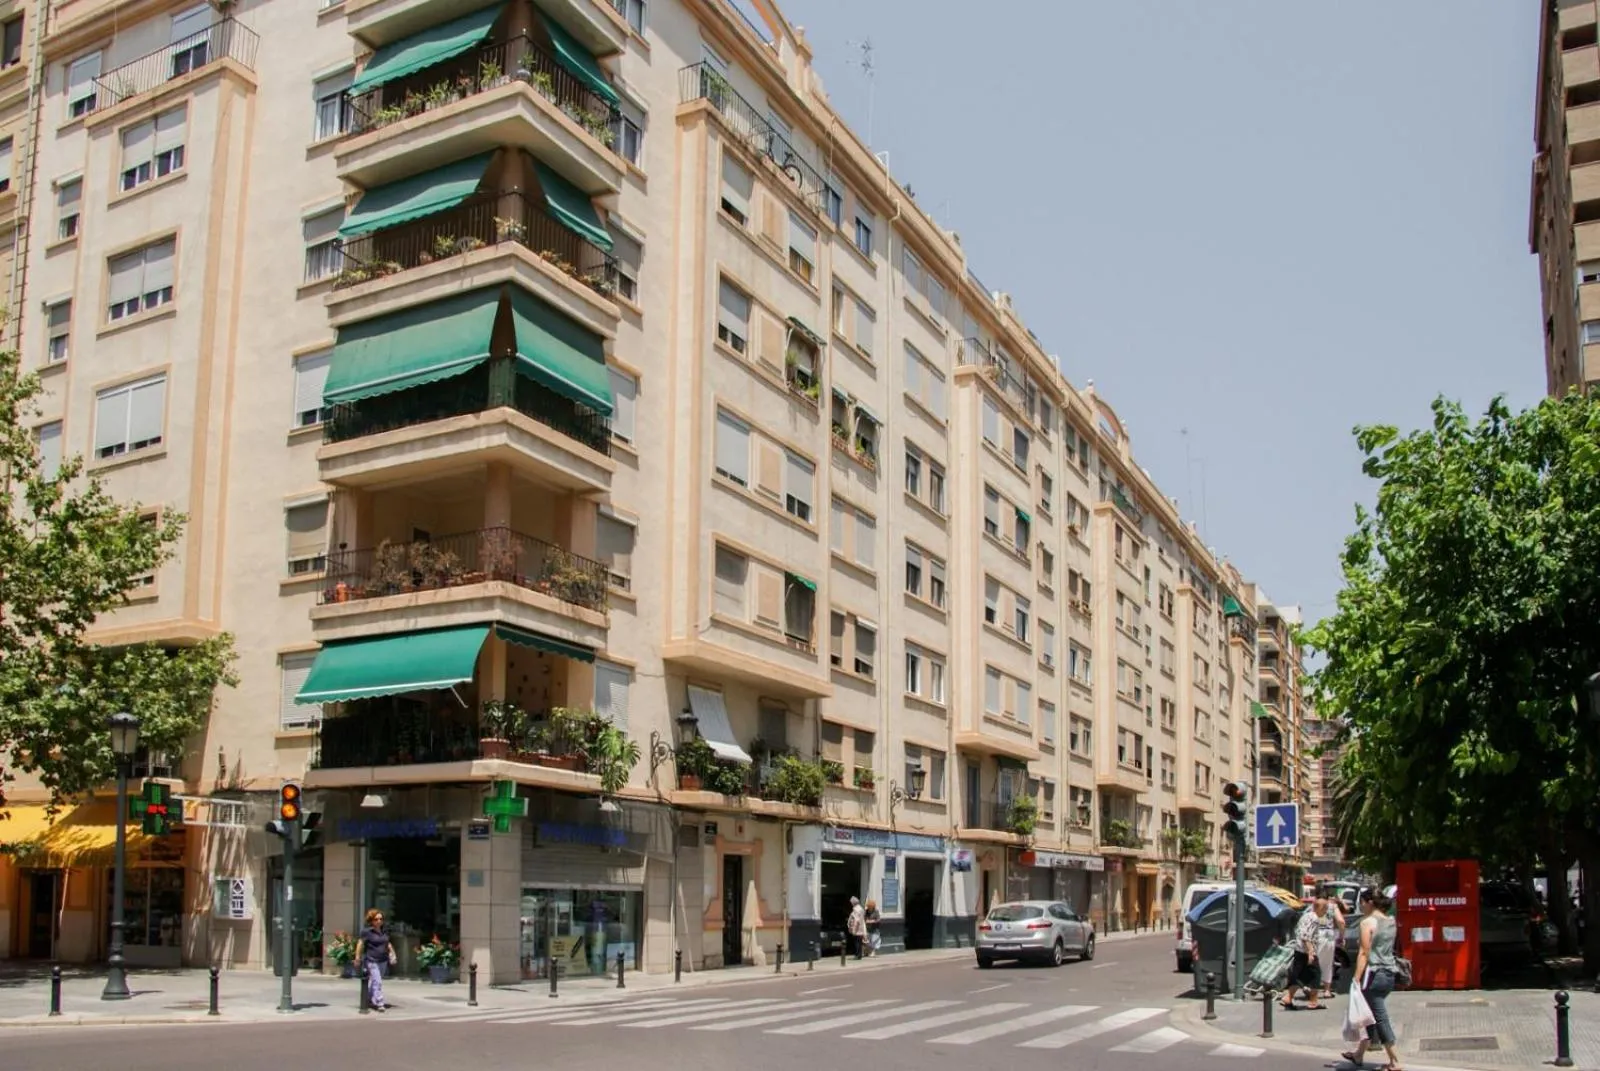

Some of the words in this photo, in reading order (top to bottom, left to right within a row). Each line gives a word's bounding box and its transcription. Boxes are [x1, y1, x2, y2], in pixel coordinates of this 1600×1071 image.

[835, 830, 853, 840] BOSCH
[1428, 897, 1434, 906] Y
[1434, 897, 1467, 905] CALZADO
